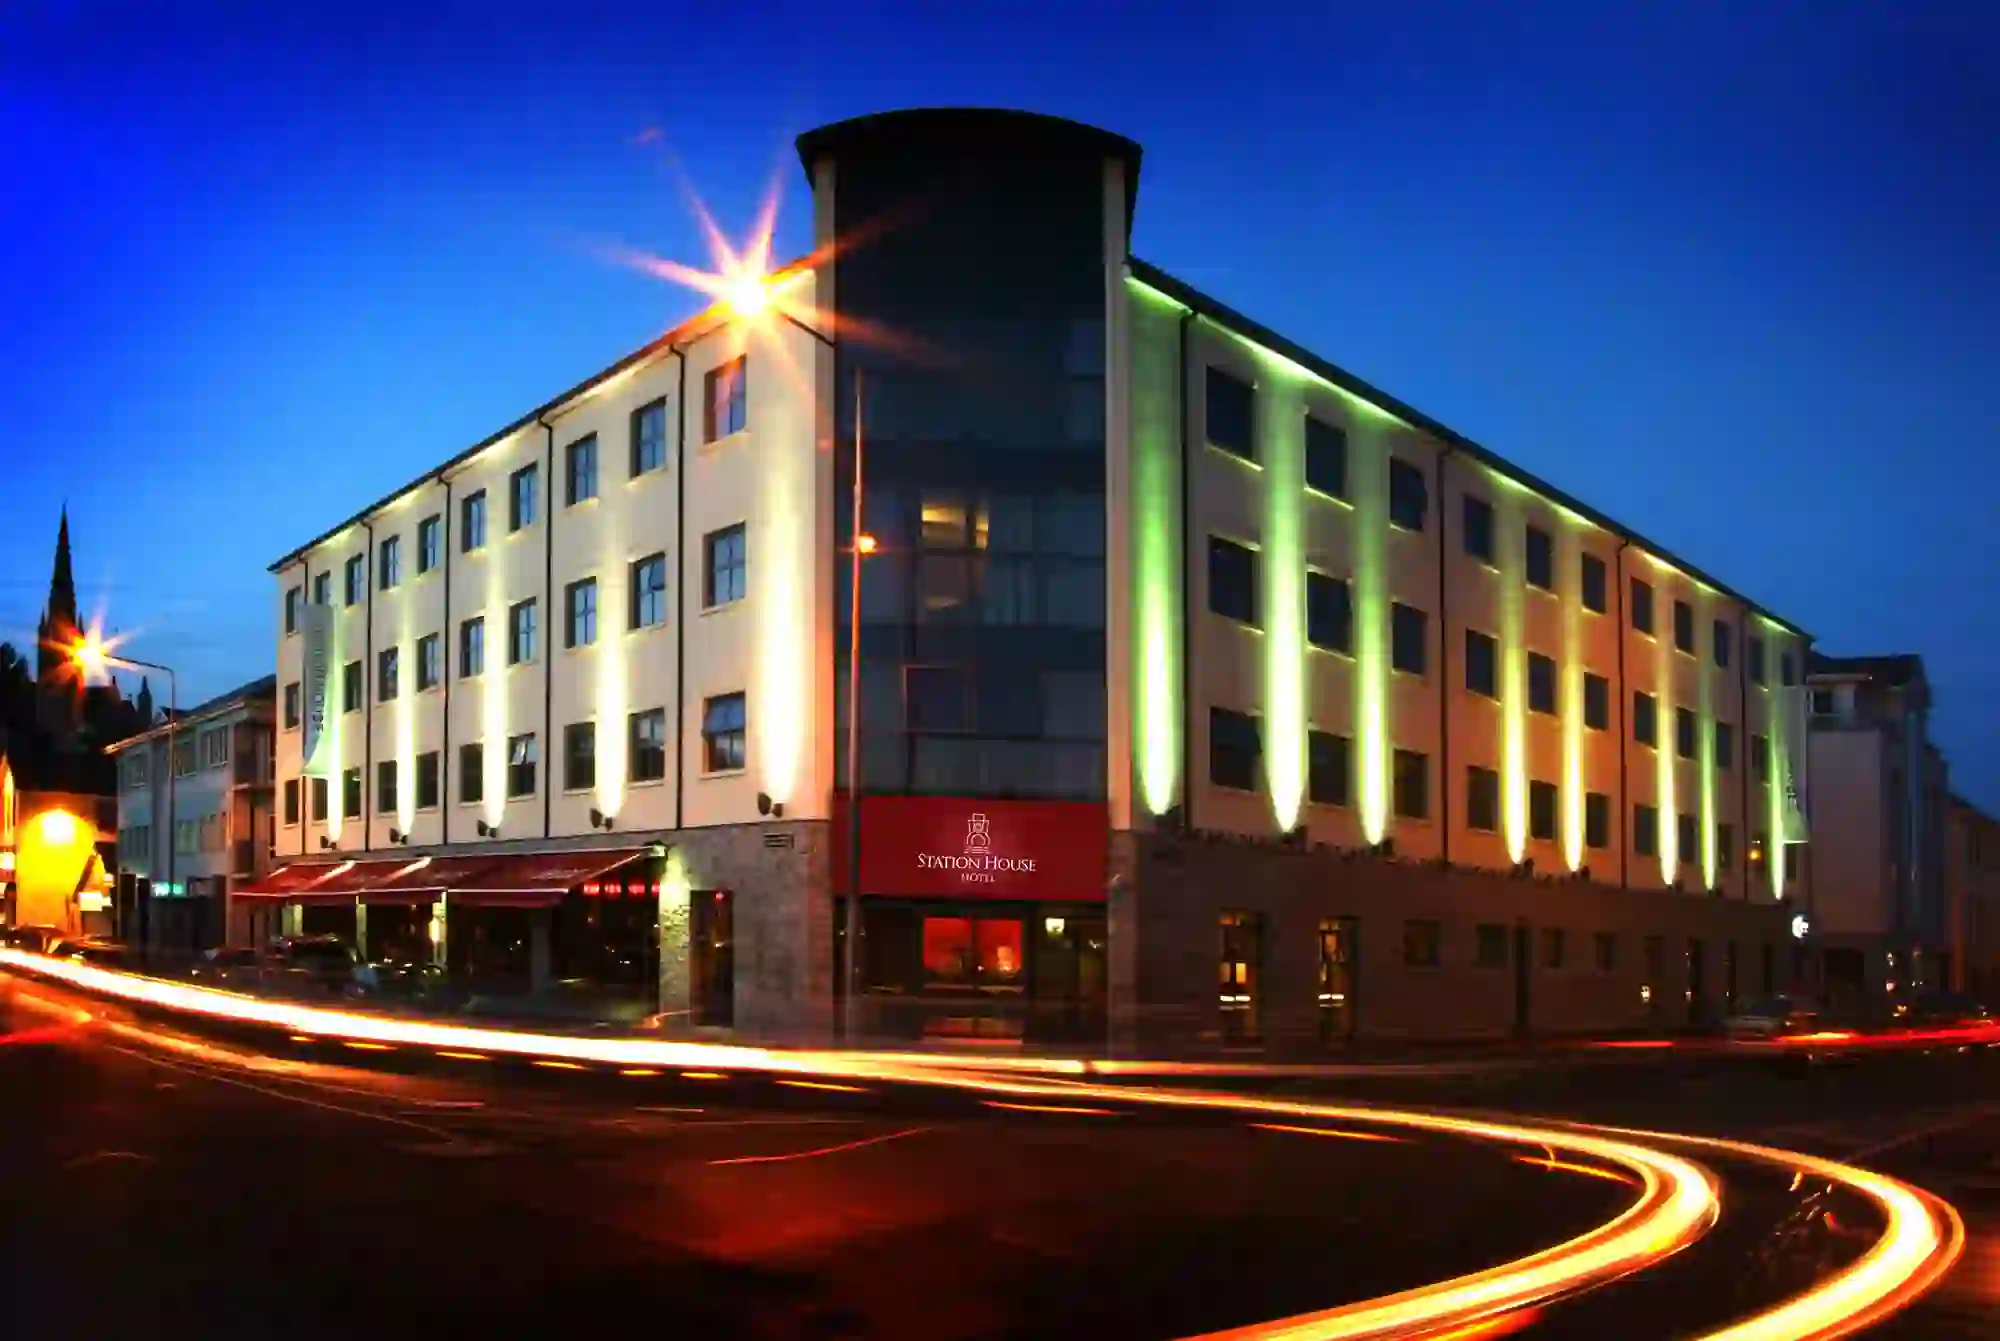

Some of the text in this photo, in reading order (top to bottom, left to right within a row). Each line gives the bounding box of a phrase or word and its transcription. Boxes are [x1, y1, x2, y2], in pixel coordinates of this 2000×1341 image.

[917, 853, 1036, 872] STATION HOUSE
[961, 872, 996, 883] HOTEL
